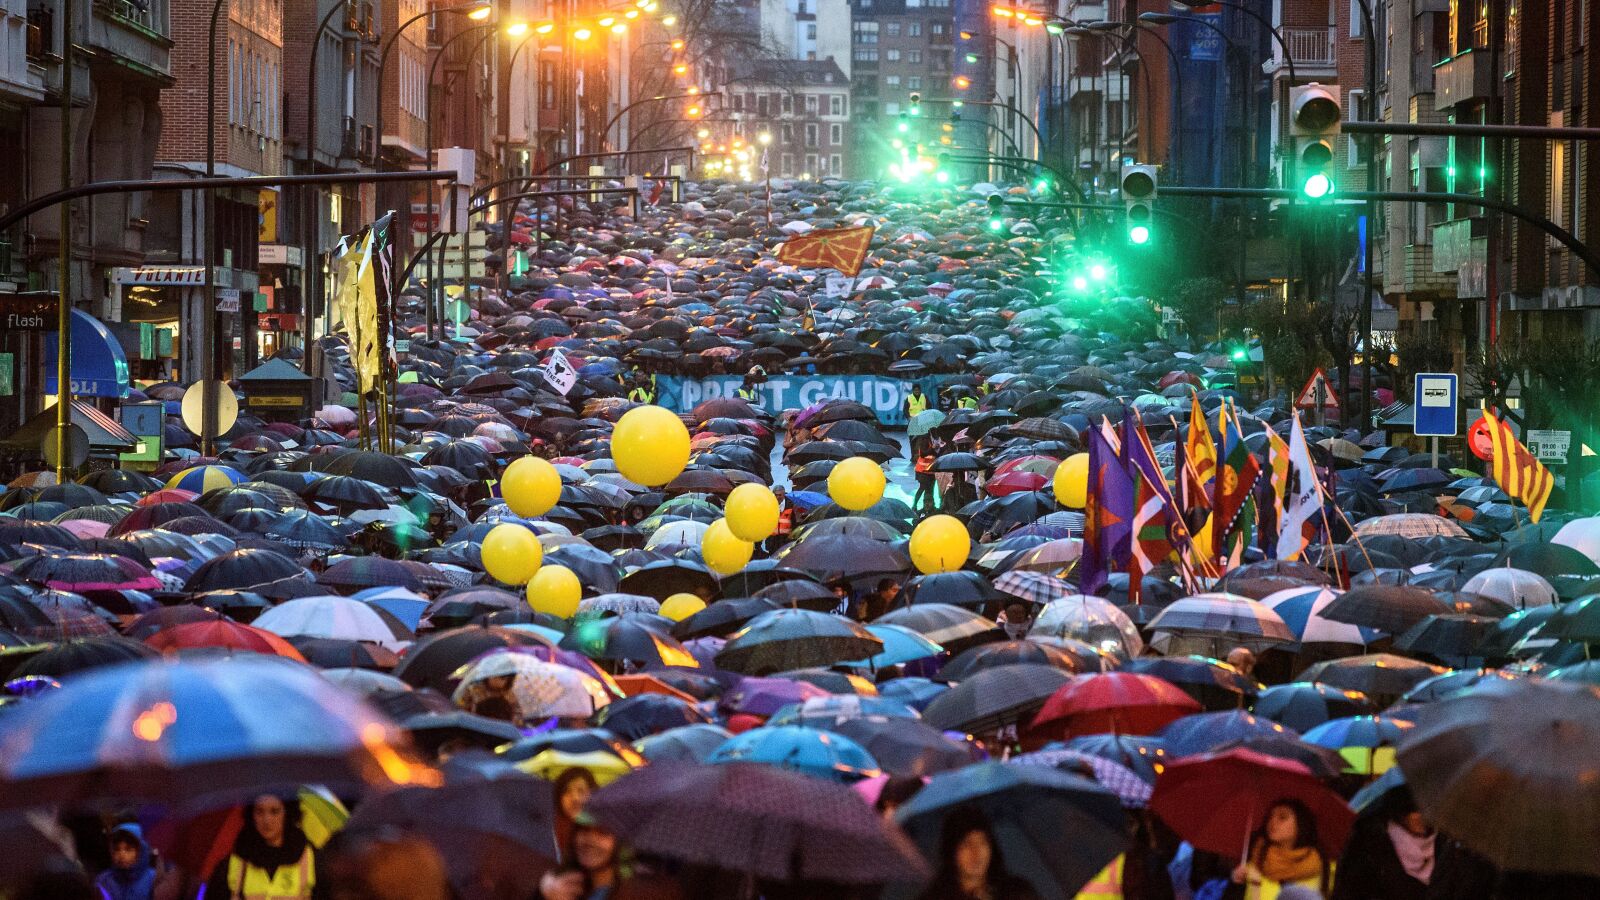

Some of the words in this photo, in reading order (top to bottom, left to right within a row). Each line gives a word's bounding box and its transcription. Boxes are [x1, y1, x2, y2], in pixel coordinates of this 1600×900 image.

[134, 267, 205, 282] VOLANTE
[8, 313, 43, 329] flash
[70, 381, 97, 394] OLI
